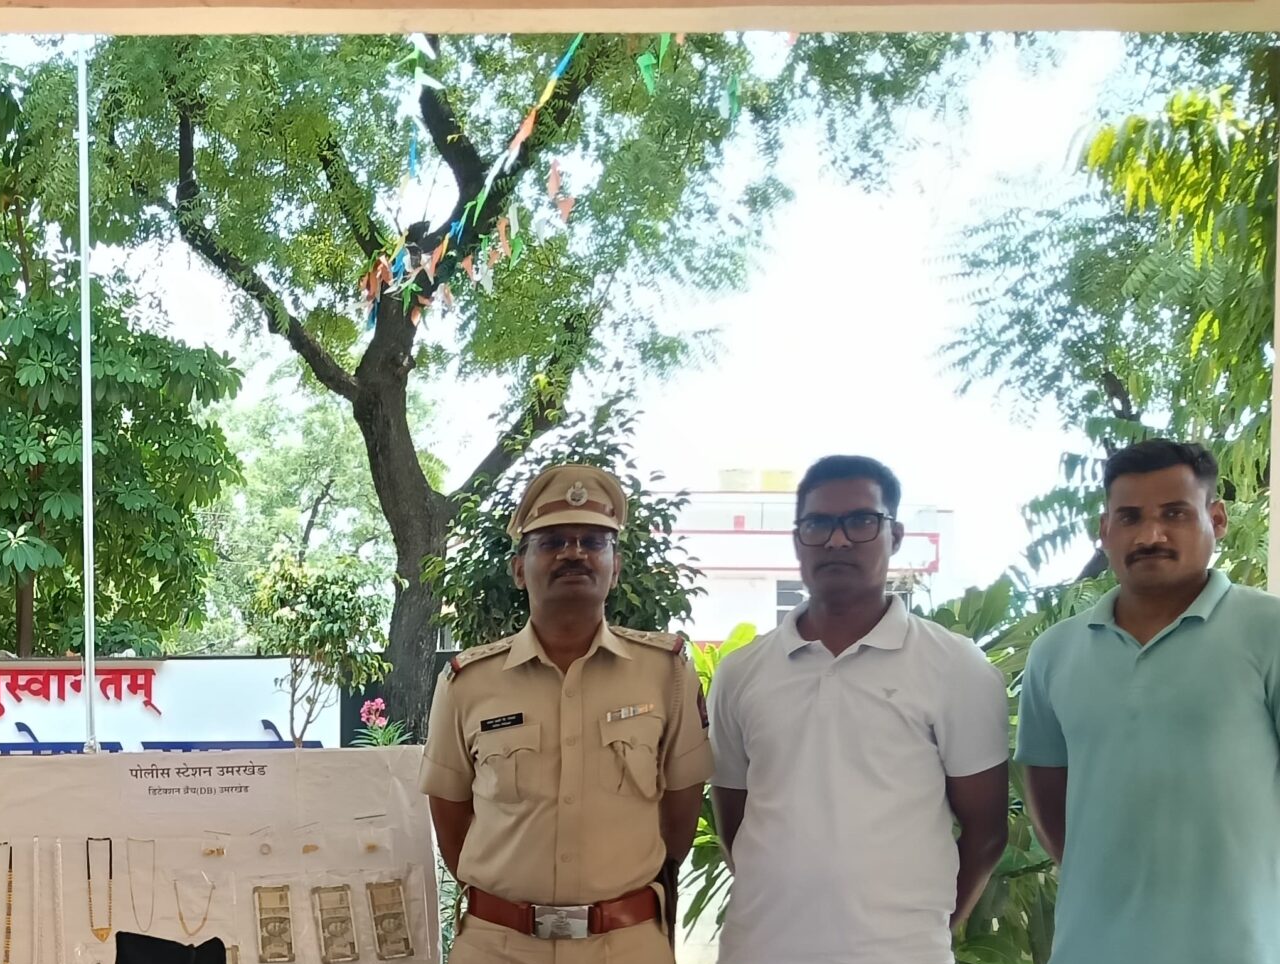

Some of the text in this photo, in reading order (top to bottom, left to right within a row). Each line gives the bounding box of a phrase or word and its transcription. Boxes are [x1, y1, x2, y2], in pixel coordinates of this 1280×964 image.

[129, 761, 267, 779] पोलीस स्टेशन उमरखेड
